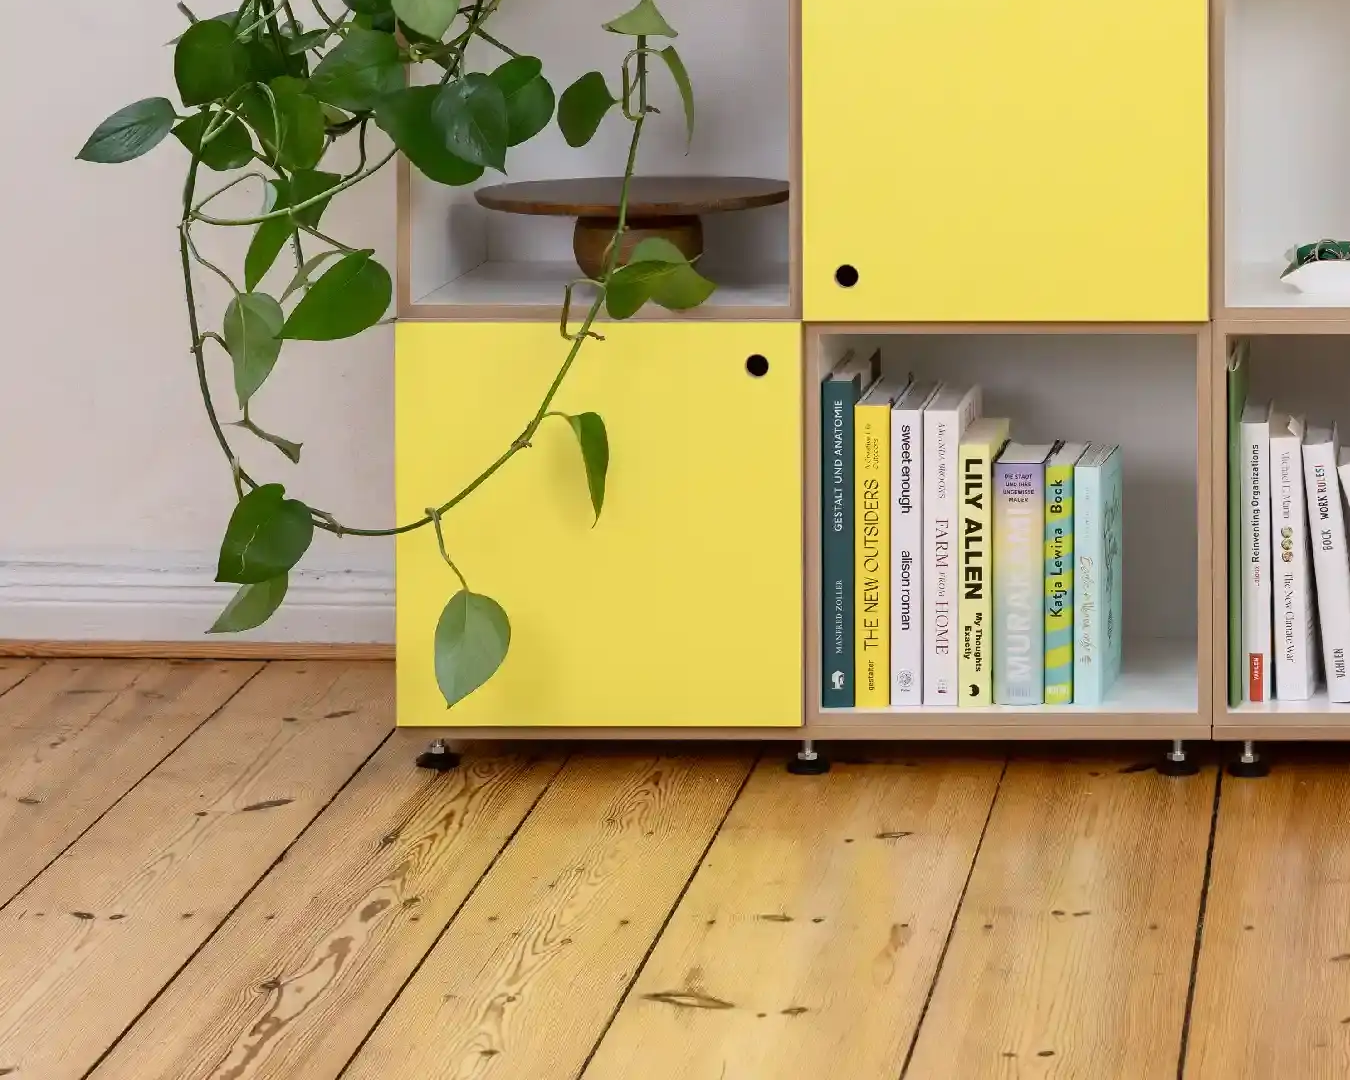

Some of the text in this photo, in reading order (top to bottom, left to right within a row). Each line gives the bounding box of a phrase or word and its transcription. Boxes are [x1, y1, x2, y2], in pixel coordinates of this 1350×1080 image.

[833, 399, 843, 532] GESTALT UND ANATOMIE
[898, 425, 912, 514] sweet enough
[1050, 479, 1063, 514] Bock
[1314, 464, 1329, 520] WORK RULES!
[964, 458, 983, 600] LILY ALLEN
[1251, 444, 1261, 563] Reinventing Organizations
[1321, 529, 1333, 551] BOCK
[863, 479, 879, 652] THE NEW OUTSIDERS
[935, 519, 949, 568] FARM
[1050, 528, 1067, 618] Katja Lewina
[835, 579, 843, 654] MANFRED ZOLLER
[901, 550, 912, 631] alison roman
[935, 601, 949, 655] HOME
[1284, 573, 1295, 663] The New Climate War
[962, 625, 972, 660] Exactly
[972, 612, 983, 672] My Thoughts
[1332, 648, 1346, 679] VAHLEN
